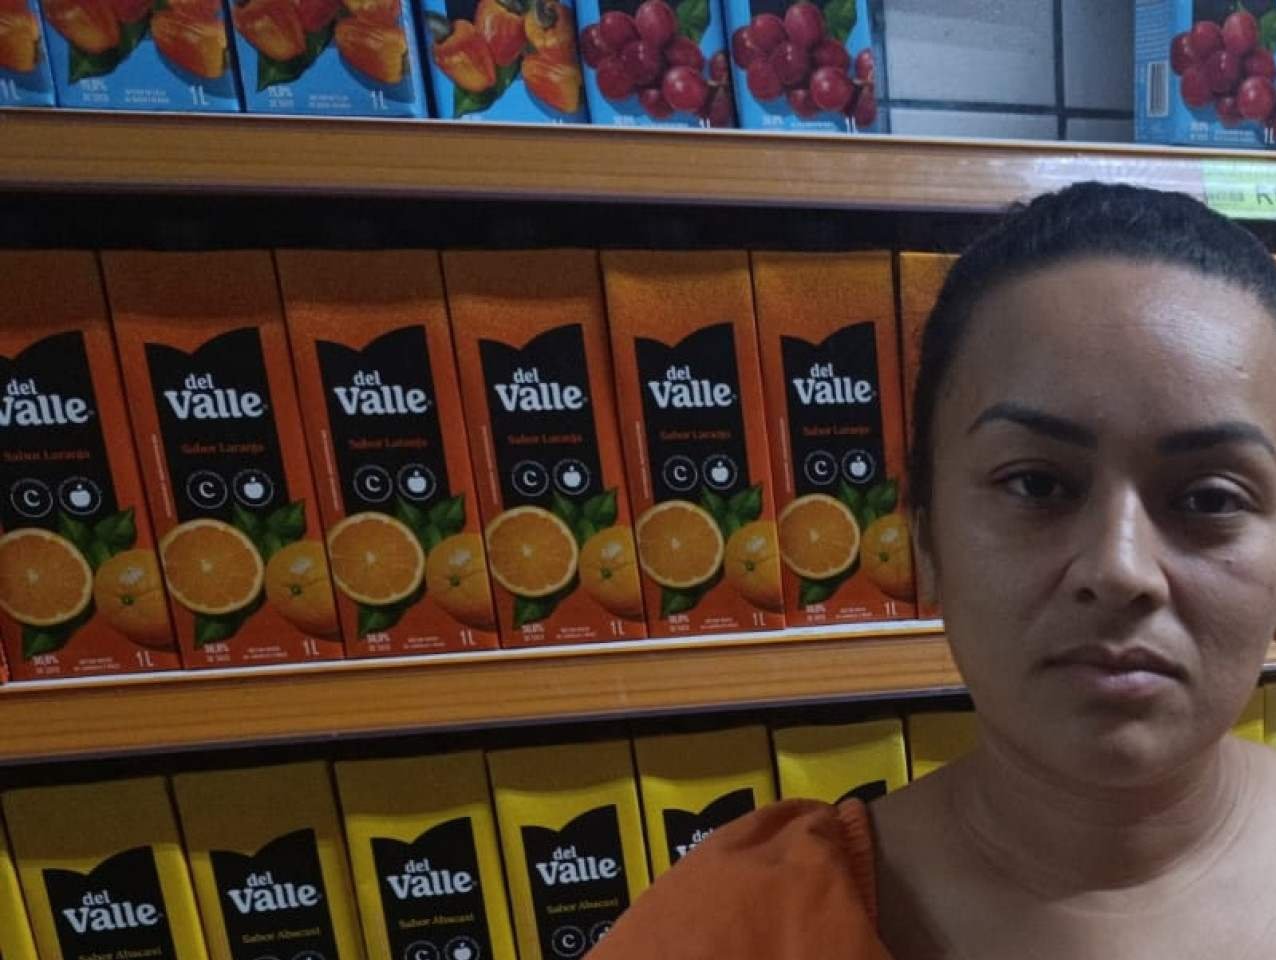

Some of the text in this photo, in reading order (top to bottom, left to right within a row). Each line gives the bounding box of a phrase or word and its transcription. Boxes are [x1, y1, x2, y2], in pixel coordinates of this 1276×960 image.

[353, 369, 383, 387] del
[513, 366, 541, 383] del
[666, 365, 691, 381] del
[810, 362, 834, 378] del
[6, 378, 37, 396] del
[184, 373, 215, 391] del
[792, 376, 873, 406] Valle
[333, 384, 429, 416] Valle
[493, 382, 585, 412] Valle
[648, 378, 733, 409] Valle
[164, 388, 266, 420] Valle
[692, 828, 713, 843] de
[553, 846, 577, 861] del
[404, 858, 430, 874] del
[536, 855, 618, 887] Valle
[247, 871, 274, 887] del
[386, 869, 473, 900] Valle
[82, 890, 110, 906] del
[228, 882, 318, 914] Valle
[62, 902, 158, 933] Valle
